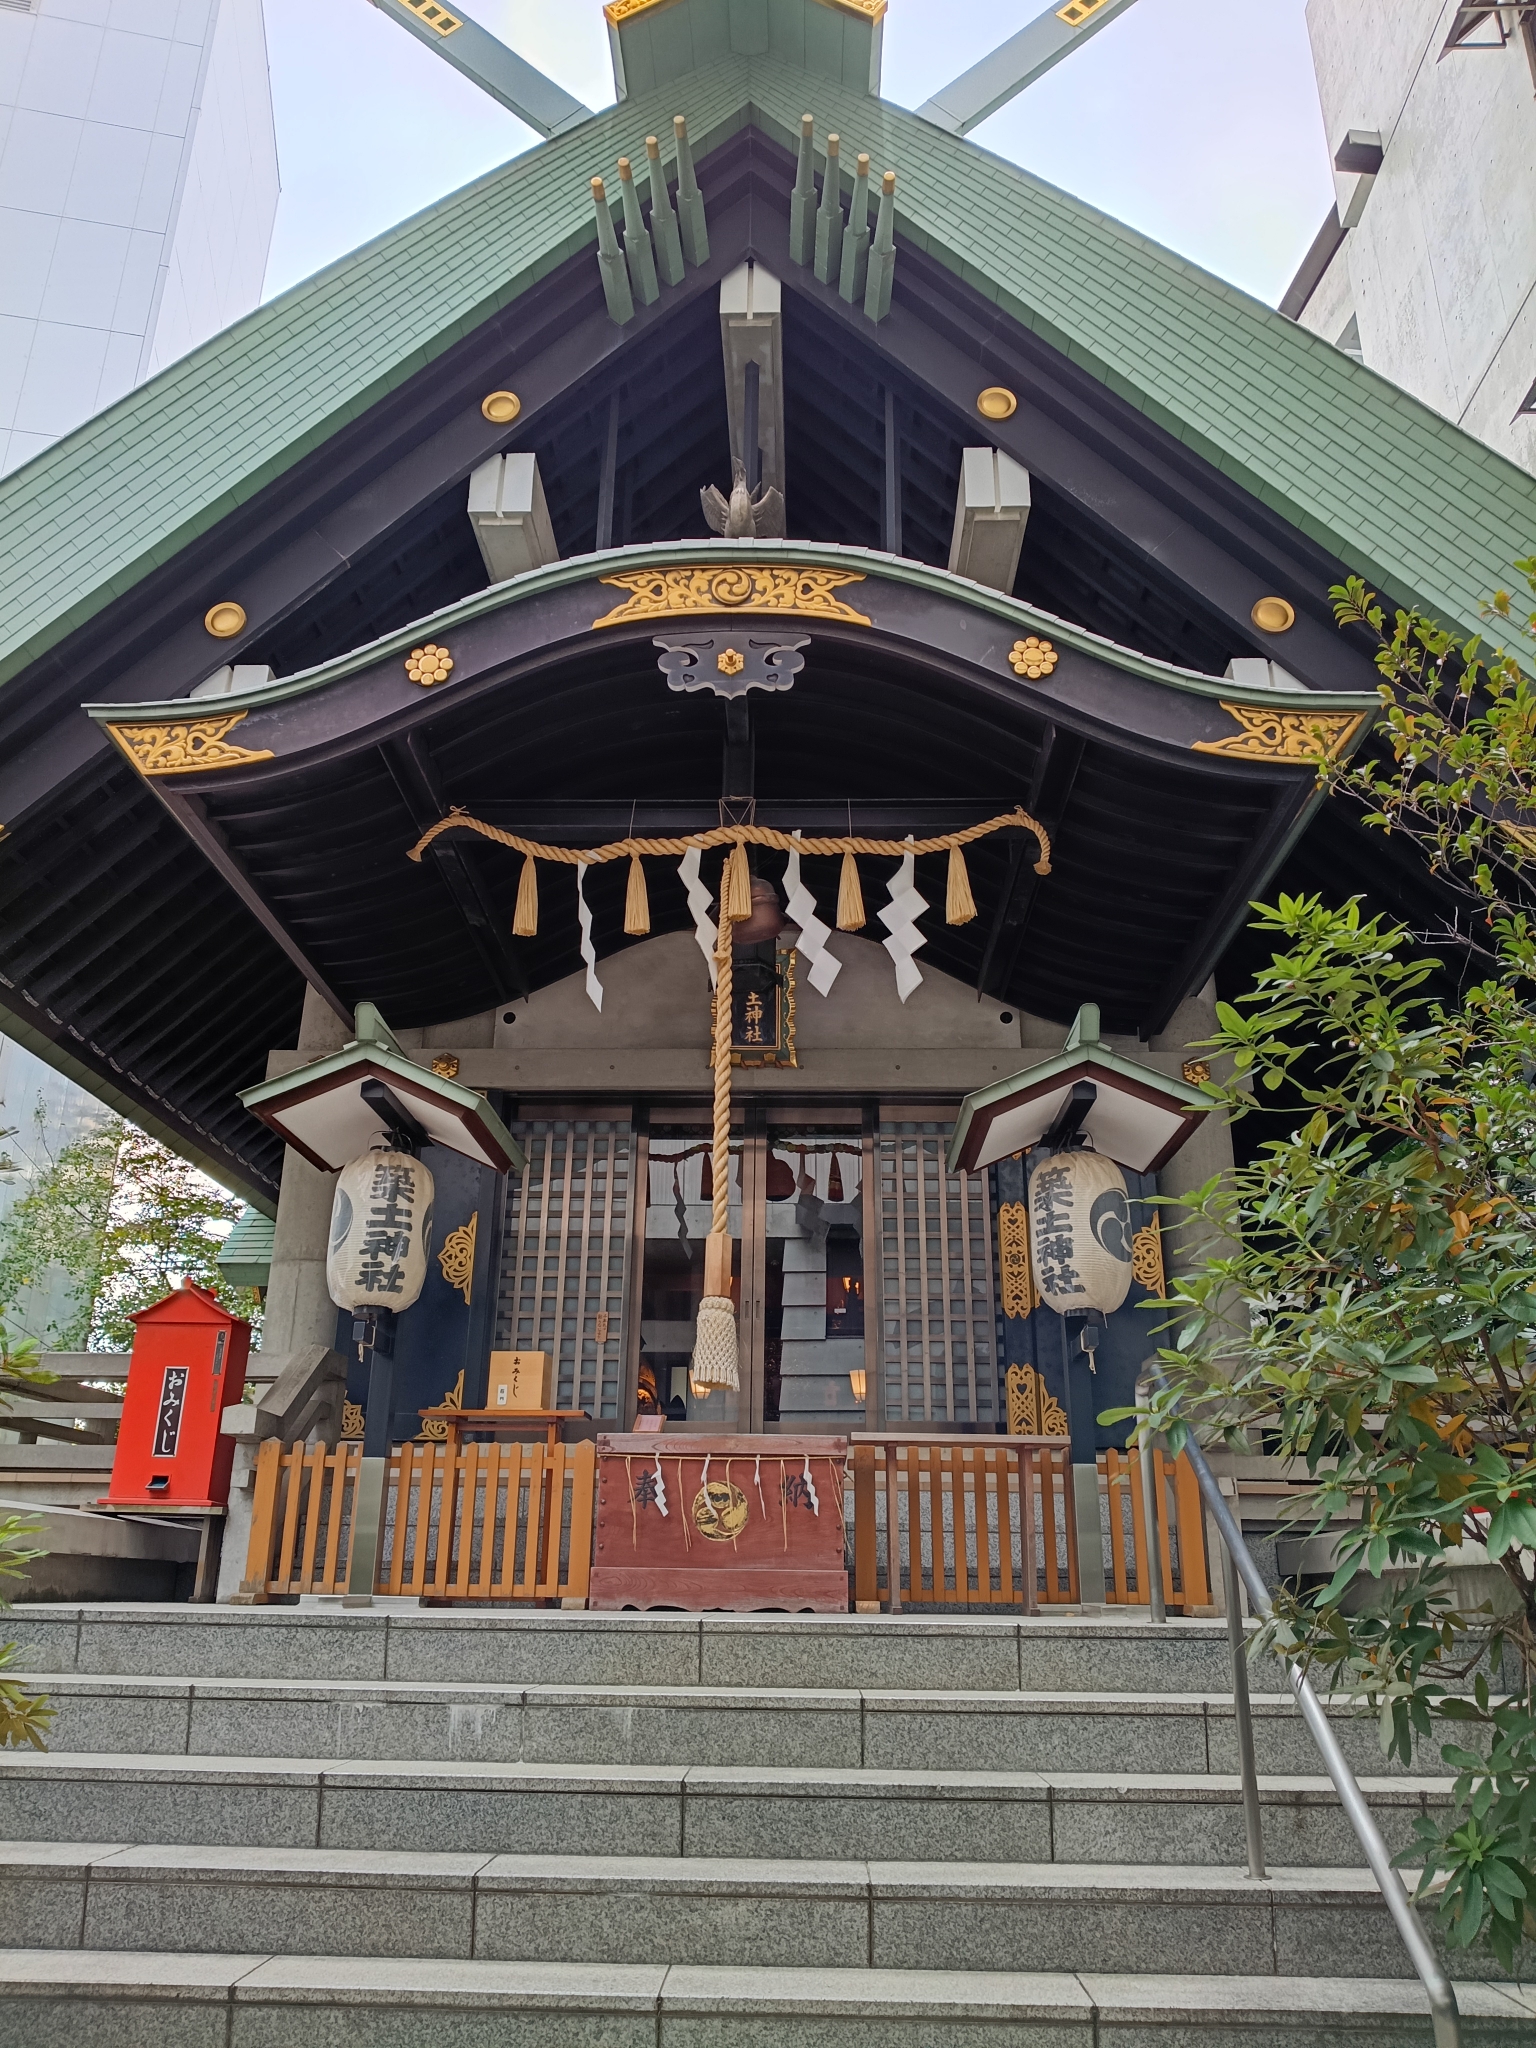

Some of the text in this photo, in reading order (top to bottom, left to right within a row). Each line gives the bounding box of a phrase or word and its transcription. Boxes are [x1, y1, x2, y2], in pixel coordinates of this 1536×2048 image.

[354, 1163, 416, 1294] 築土神社
[1033, 1166, 1087, 1296] 築土神社
[162, 1370, 185, 1453] おみくじ
[511, 1356, 522, 1399] おみくじ
[630, 1469, 658, 1510] 奉
